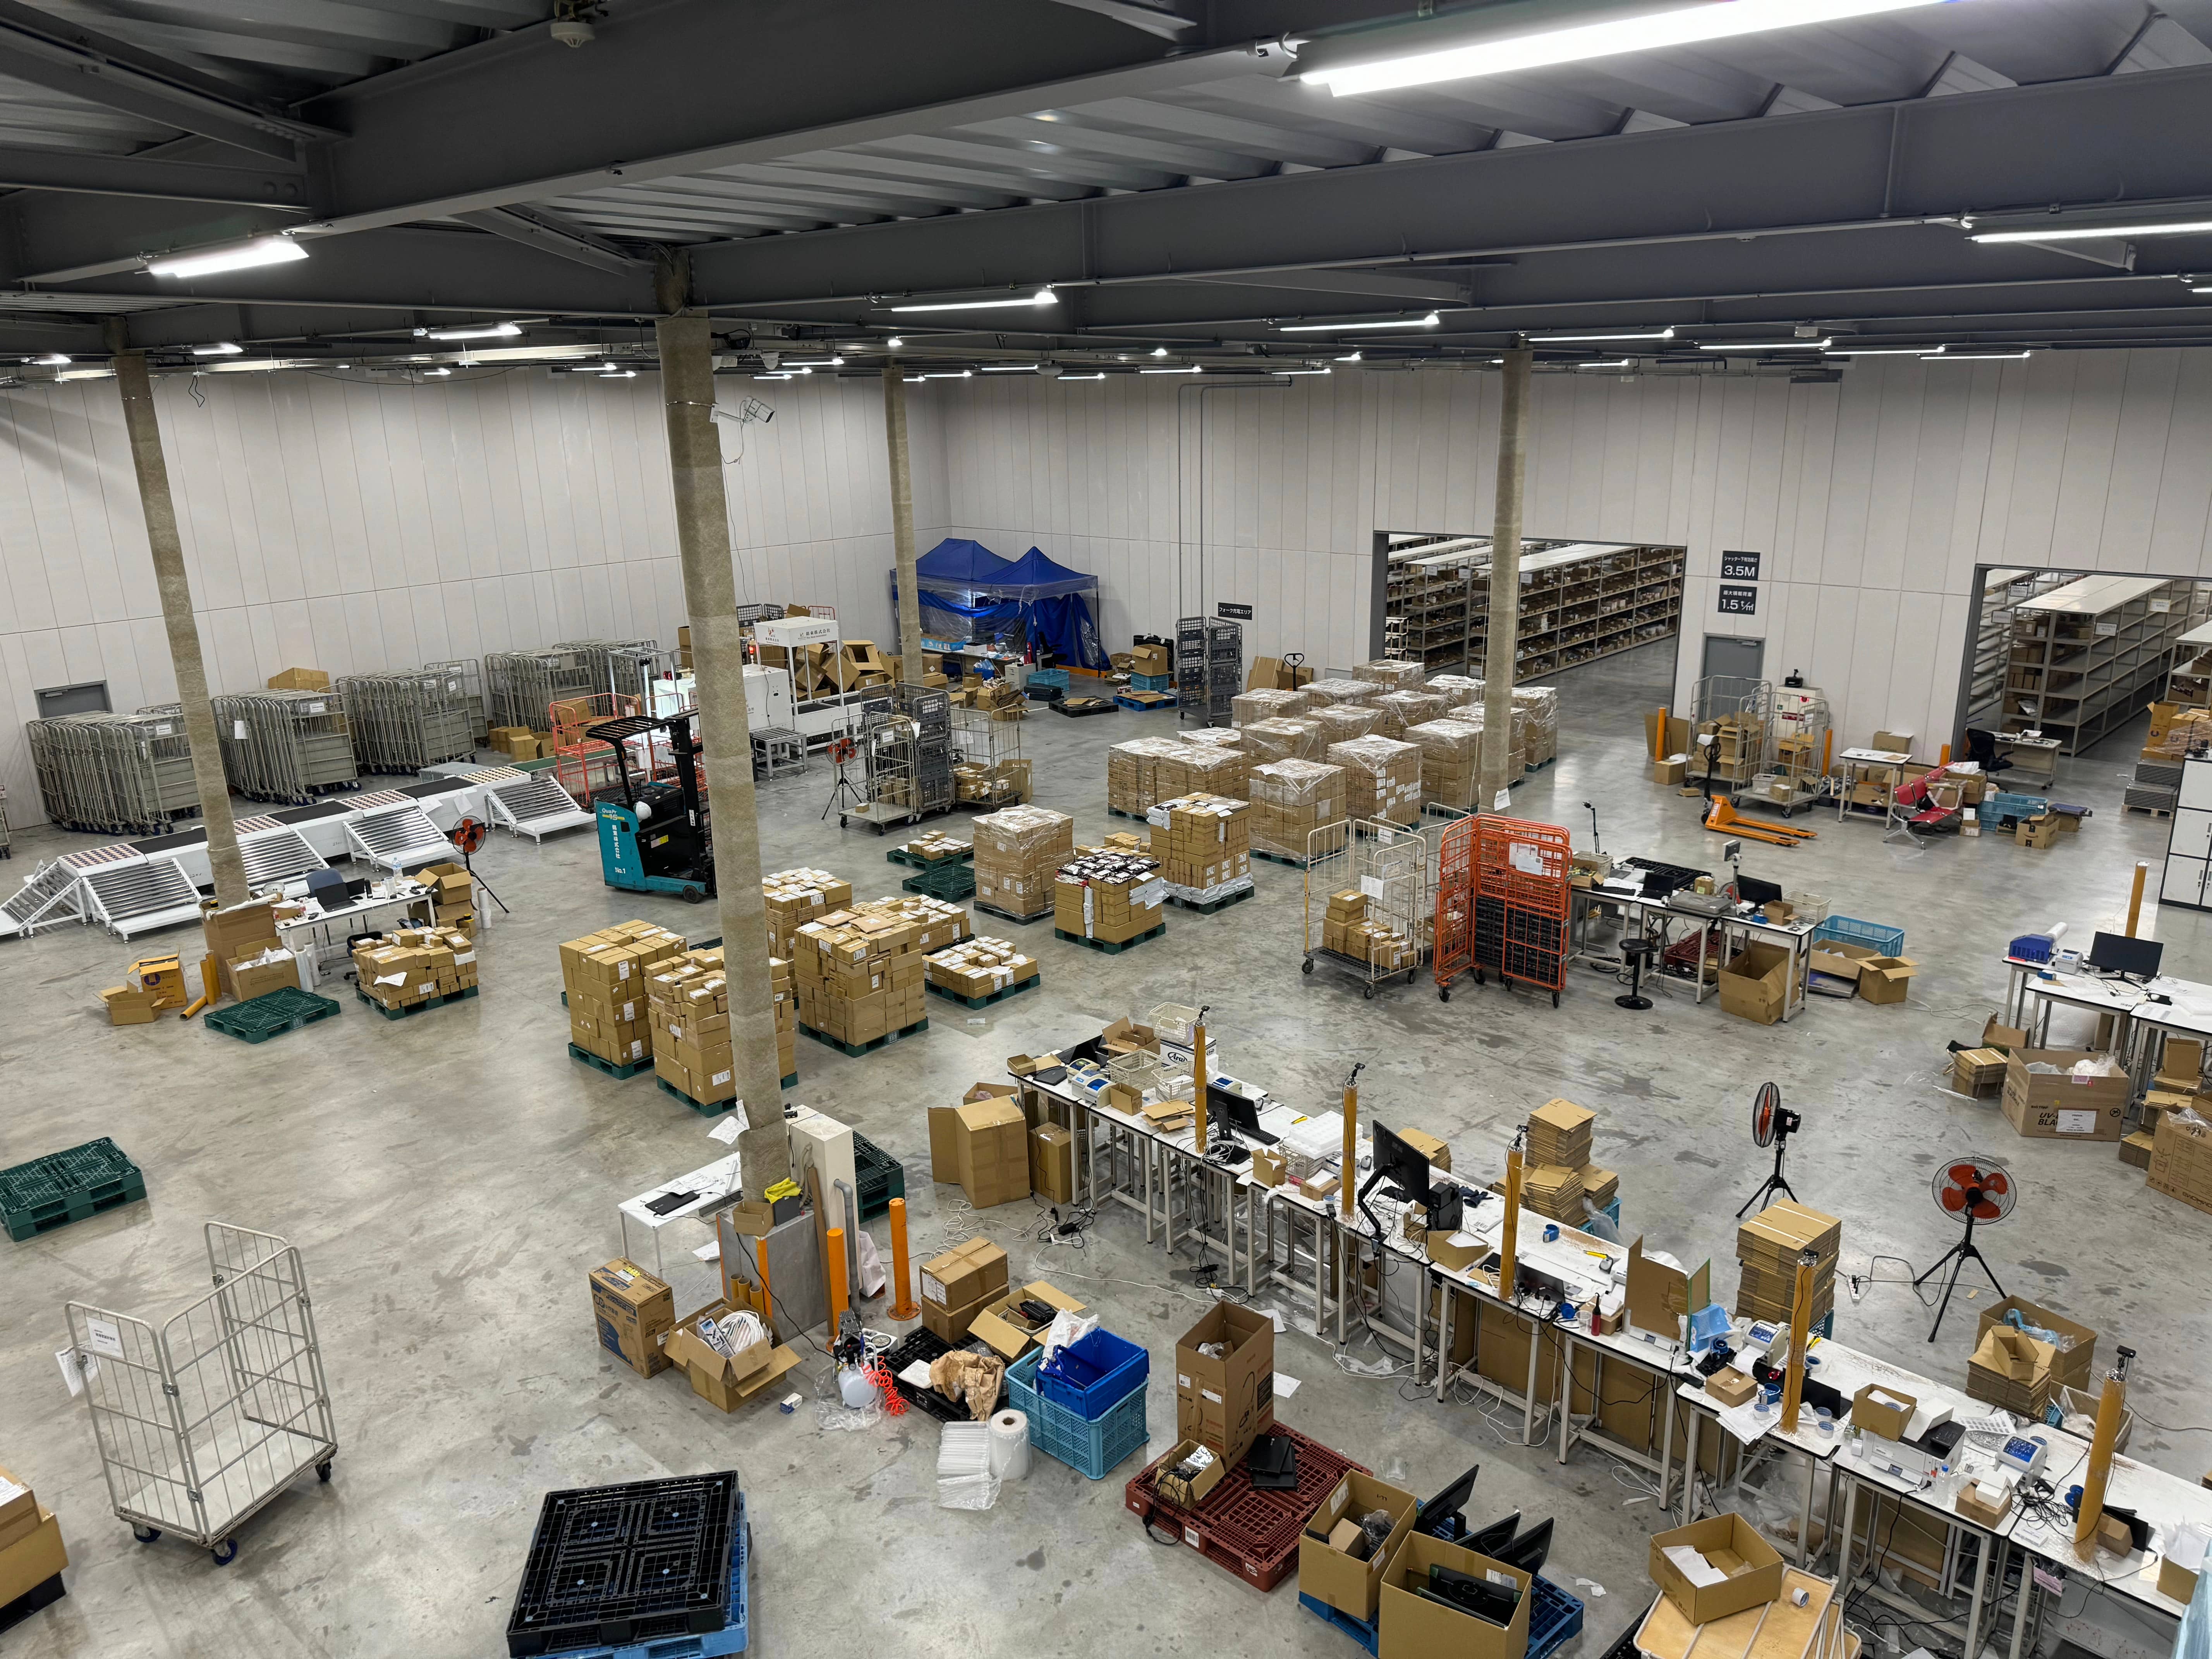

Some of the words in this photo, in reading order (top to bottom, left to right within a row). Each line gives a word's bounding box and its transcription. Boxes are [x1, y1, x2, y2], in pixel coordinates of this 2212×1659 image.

[1724, 565, 1755, 577] 3.5M
[1722, 599, 1738, 610] 1.5
[1219, 607, 1251, 615] フォーク充電エリア
[1170, 1053, 1185, 1062] Arai
